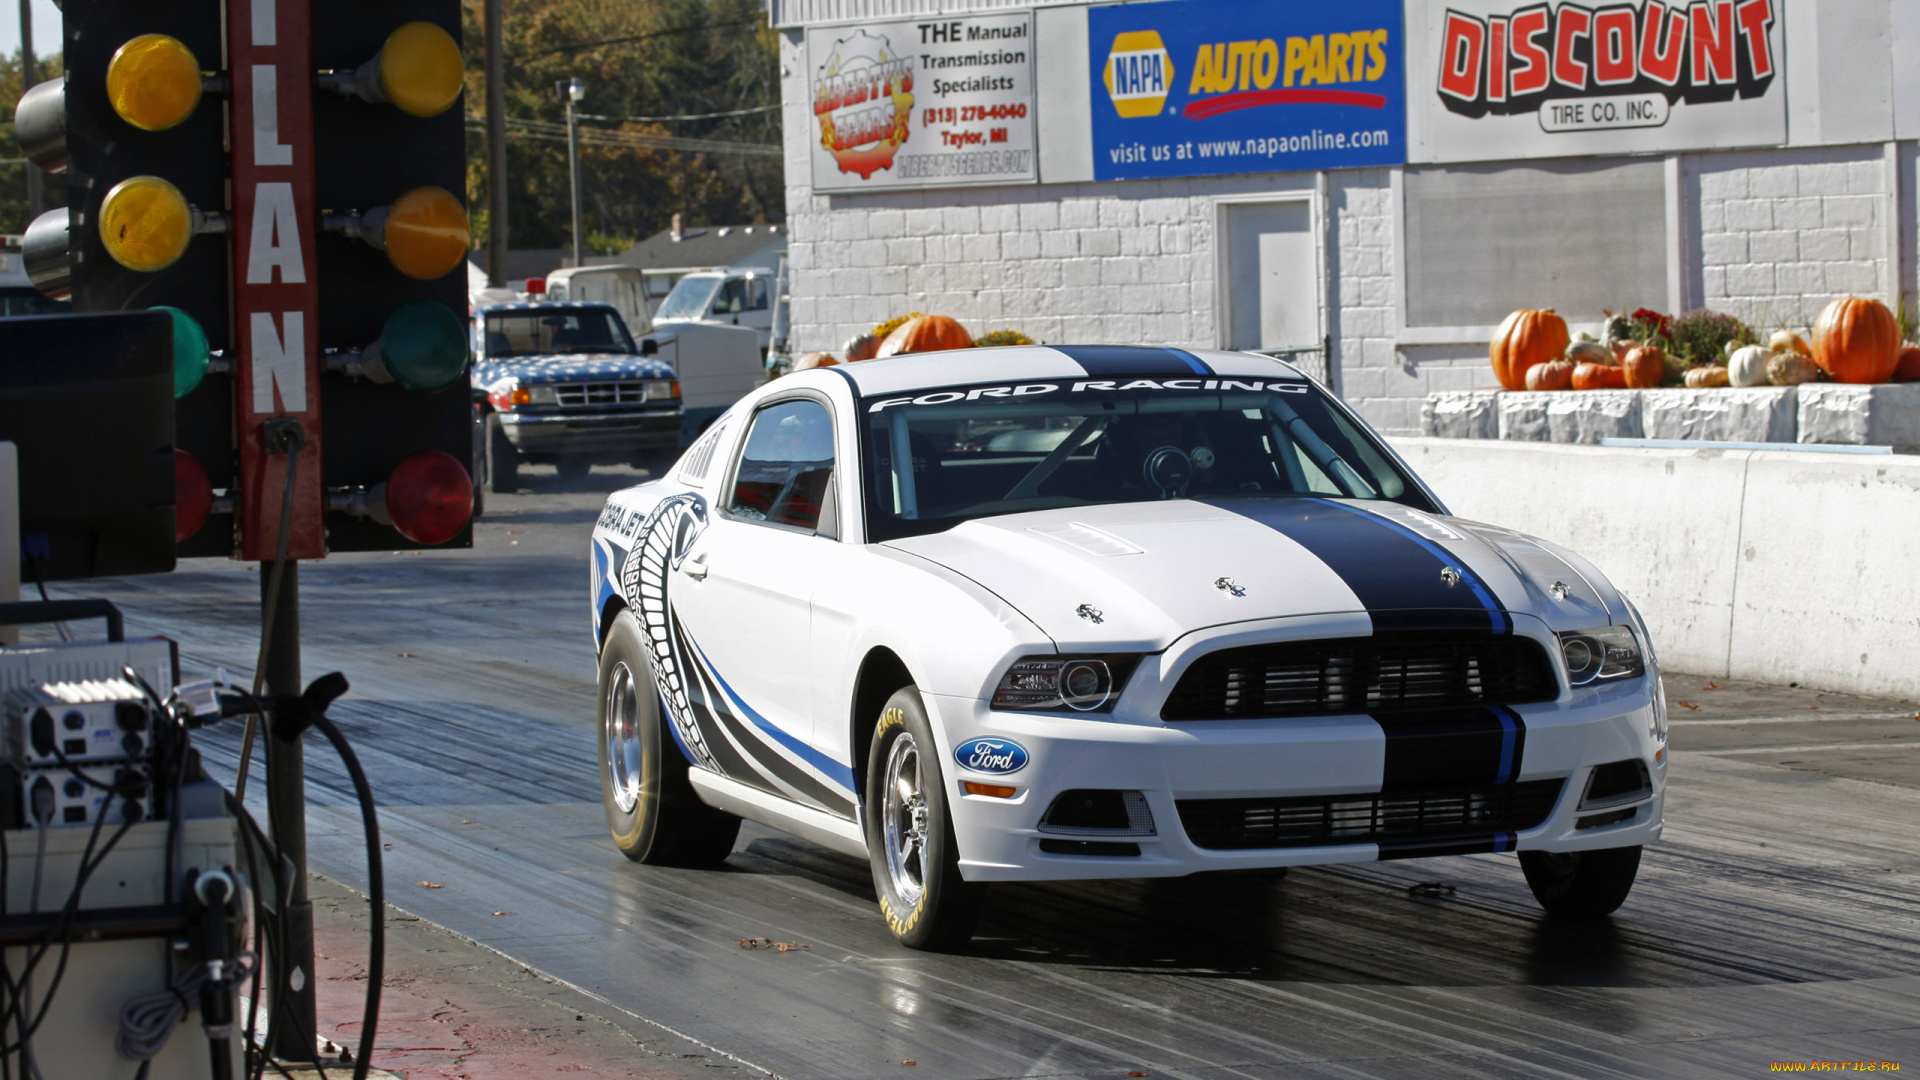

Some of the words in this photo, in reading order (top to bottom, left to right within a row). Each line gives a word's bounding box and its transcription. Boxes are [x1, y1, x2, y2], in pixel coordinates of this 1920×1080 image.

[917, 22, 963, 45] THE
[966, 22, 1028, 42] Manual
[920, 49, 1025, 69] Transmission
[1188, 38, 1280, 95] AUTO
[1283, 28, 1388, 88] PARTS
[1437, 0, 1775, 113] DISCOUNT
[932, 75, 1014, 98] Specialists
[1115, 53, 1164, 95] NAPA
[831, 104, 895, 151] GEARS
[923, 106, 957, 127] (313)
[960, 103, 1027, 122] 278-4040
[1551, 102, 1584, 124] TIRE
[1592, 101, 1619, 123] CO.
[1626, 100, 1658, 121] INC.
[941, 130, 987, 149] Taylor,
[990, 128, 1008, 143] MI
[1110, 143, 1146, 163] visit
[1151, 144, 1171, 161] us
[1176, 141, 1194, 159] at
[1198, 129, 1389, 158] www.napaonline.com
[868, 383, 1059, 413] FORD
[1071, 379, 1309, 395] RACING
[877, 707, 904, 739] EAGLE
[969, 741, 1015, 770] Ford
[879, 883, 928, 936] GOODYEAR
